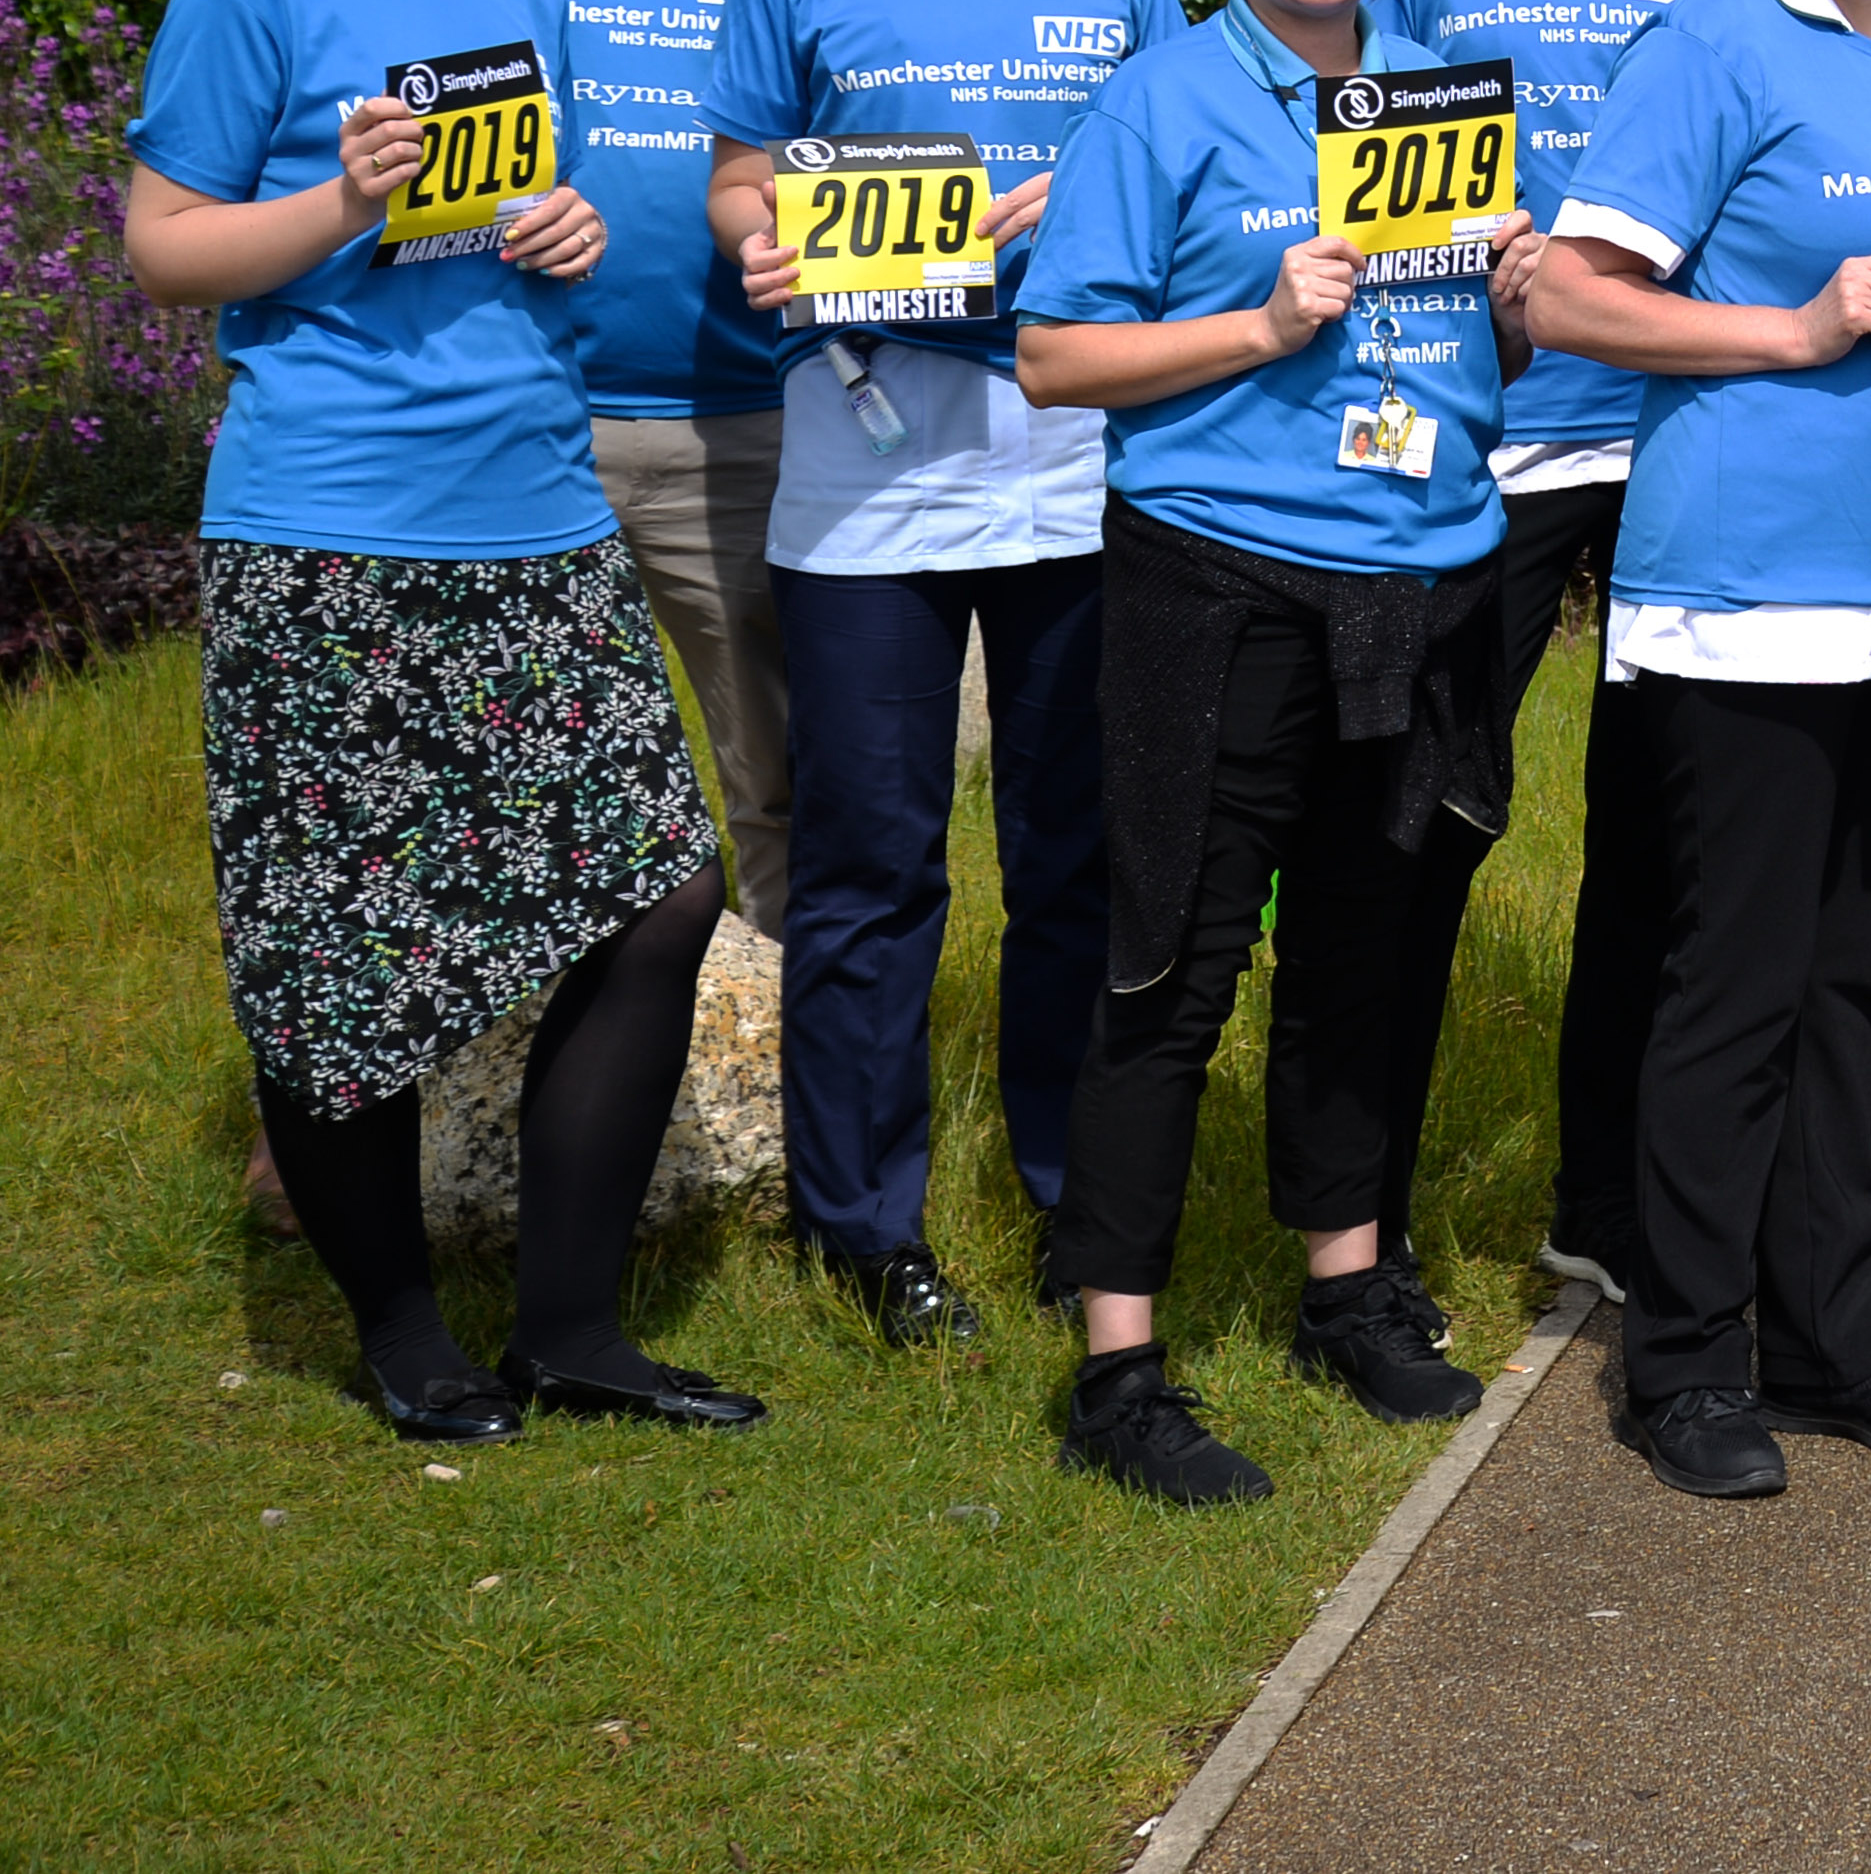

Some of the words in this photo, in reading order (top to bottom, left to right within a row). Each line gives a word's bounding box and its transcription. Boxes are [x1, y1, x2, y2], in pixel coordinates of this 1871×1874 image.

[568, 0, 655, 27] hester
[1438, 2, 1582, 39] Manchester
[608, 29, 645, 46] NHS
[649, 32, 716, 51] Founda
[1040, 19, 1124, 52] NHS
[1539, 28, 1575, 44] NHS
[441, 58, 532, 93] Simplyhealth
[831, 61, 994, 94] Manchester
[571, 78, 701, 106] Ryma
[950, 86, 988, 102] NHS
[993, 86, 1089, 102] Foundation
[1391, 78, 1502, 110] Simplyhealth
[586, 127, 715, 152] #TeamMFT
[841, 142, 965, 161] Simplyhealth
[405, 102, 540, 211] 2019
[1342, 122, 1505, 225] 2019
[803, 174, 974, 260] 2019
[814, 287, 968, 324] MANCHESTER
[1350, 291, 1479, 318] yman
